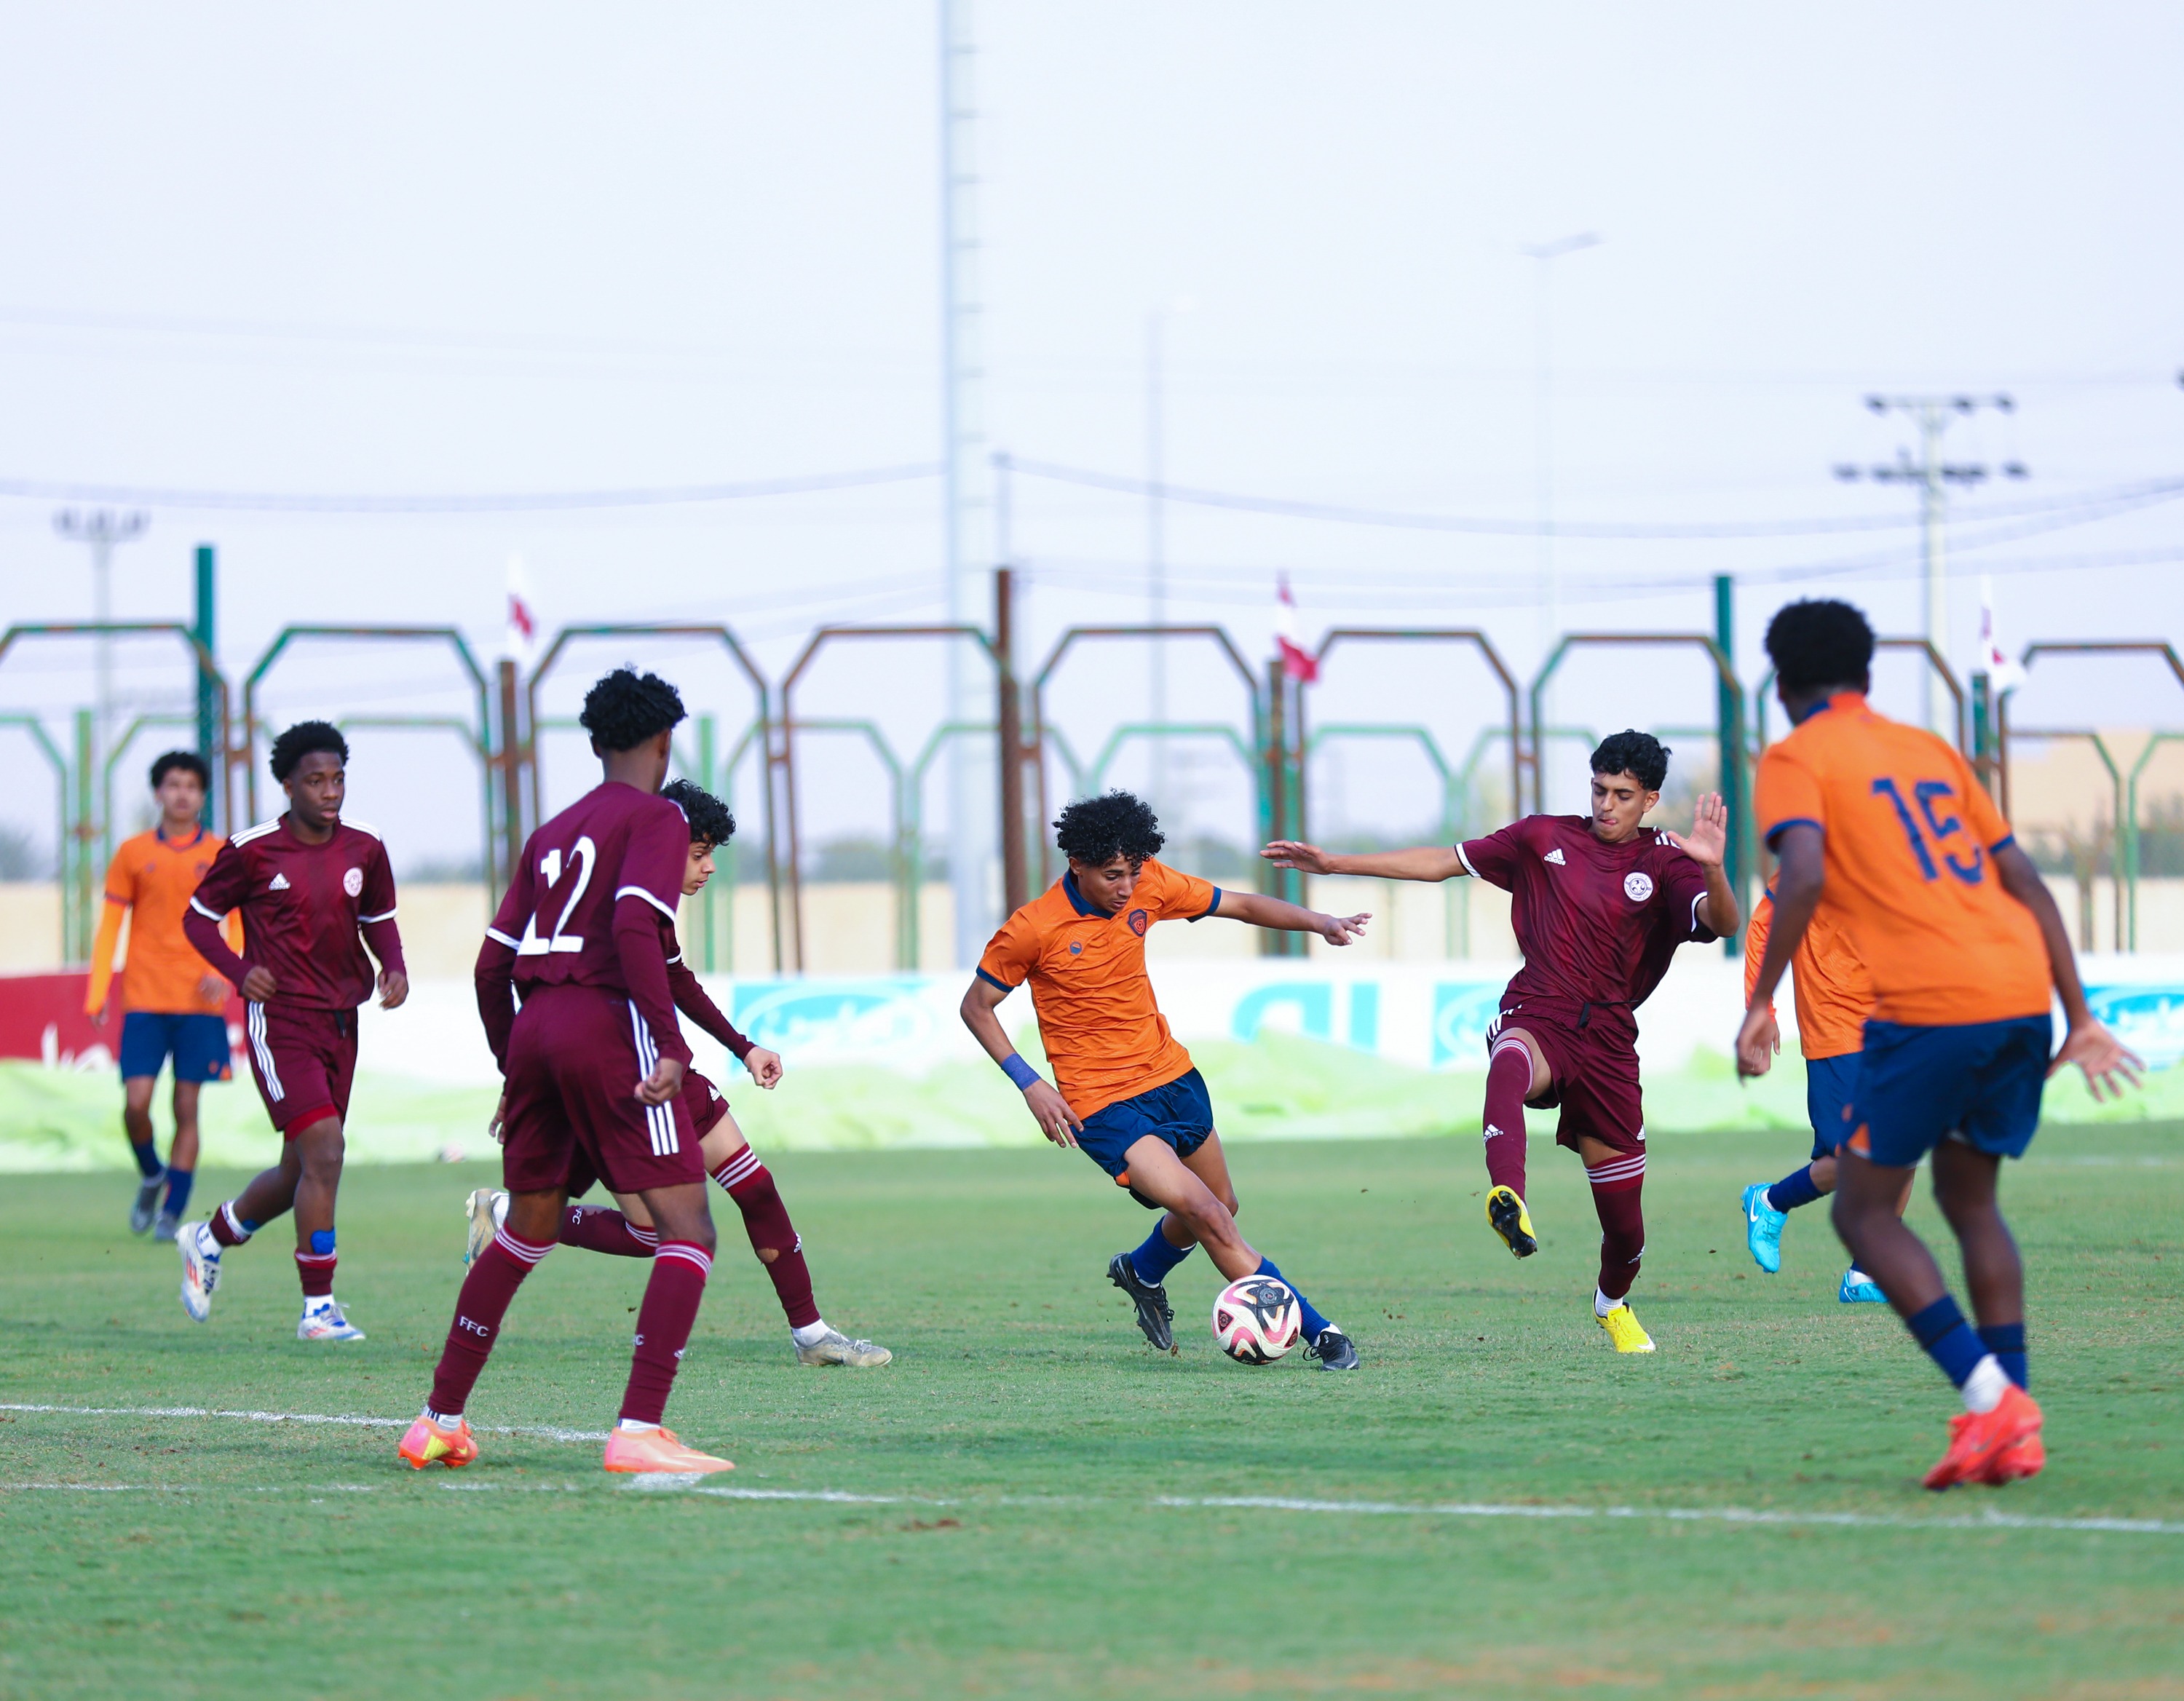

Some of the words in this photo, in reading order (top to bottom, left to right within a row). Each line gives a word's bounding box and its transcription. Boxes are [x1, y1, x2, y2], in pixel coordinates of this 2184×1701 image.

[1543, 855, 1566, 866] adidas
[1872, 779, 1983, 885] 15
[517, 836, 596, 955] 12
[459, 1316, 489, 1337] FFC
